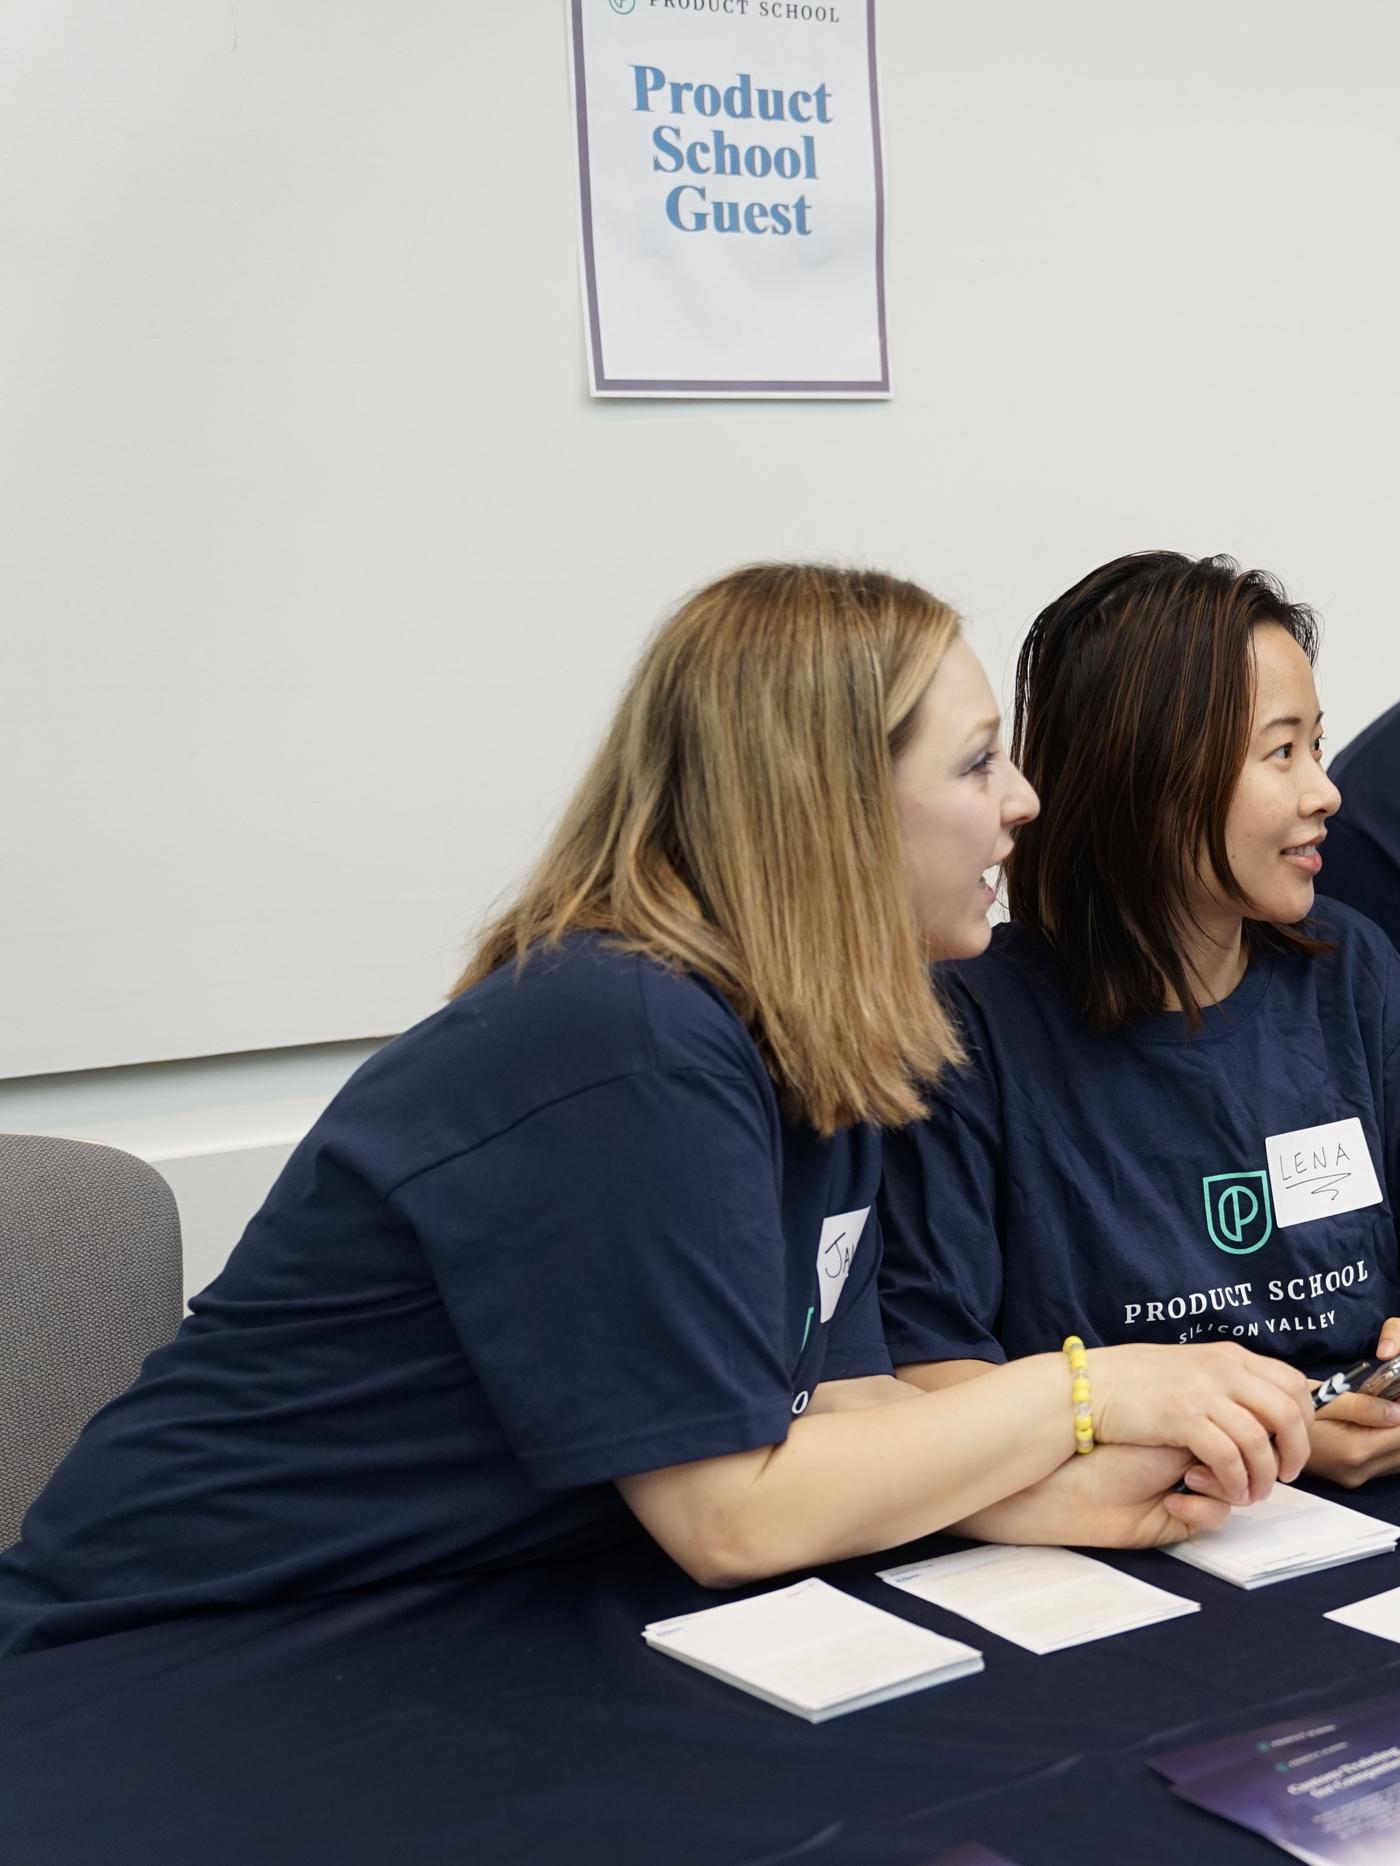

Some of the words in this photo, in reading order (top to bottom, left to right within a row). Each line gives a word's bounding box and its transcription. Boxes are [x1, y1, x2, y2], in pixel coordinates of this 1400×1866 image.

[759, 2, 840, 23] SCHOOL
[628, 64, 833, 124] Product
[651, 124, 820, 180] School
[664, 184, 813, 237] Guest
[1279, 1143, 1351, 1182] LENA
[1124, 1282, 1252, 1325] PRODUCT
[1268, 1260, 1369, 1302] SCHOOL
[1179, 1322, 1259, 1345] SILICON
[1265, 1310, 1336, 1334] VALLEY
